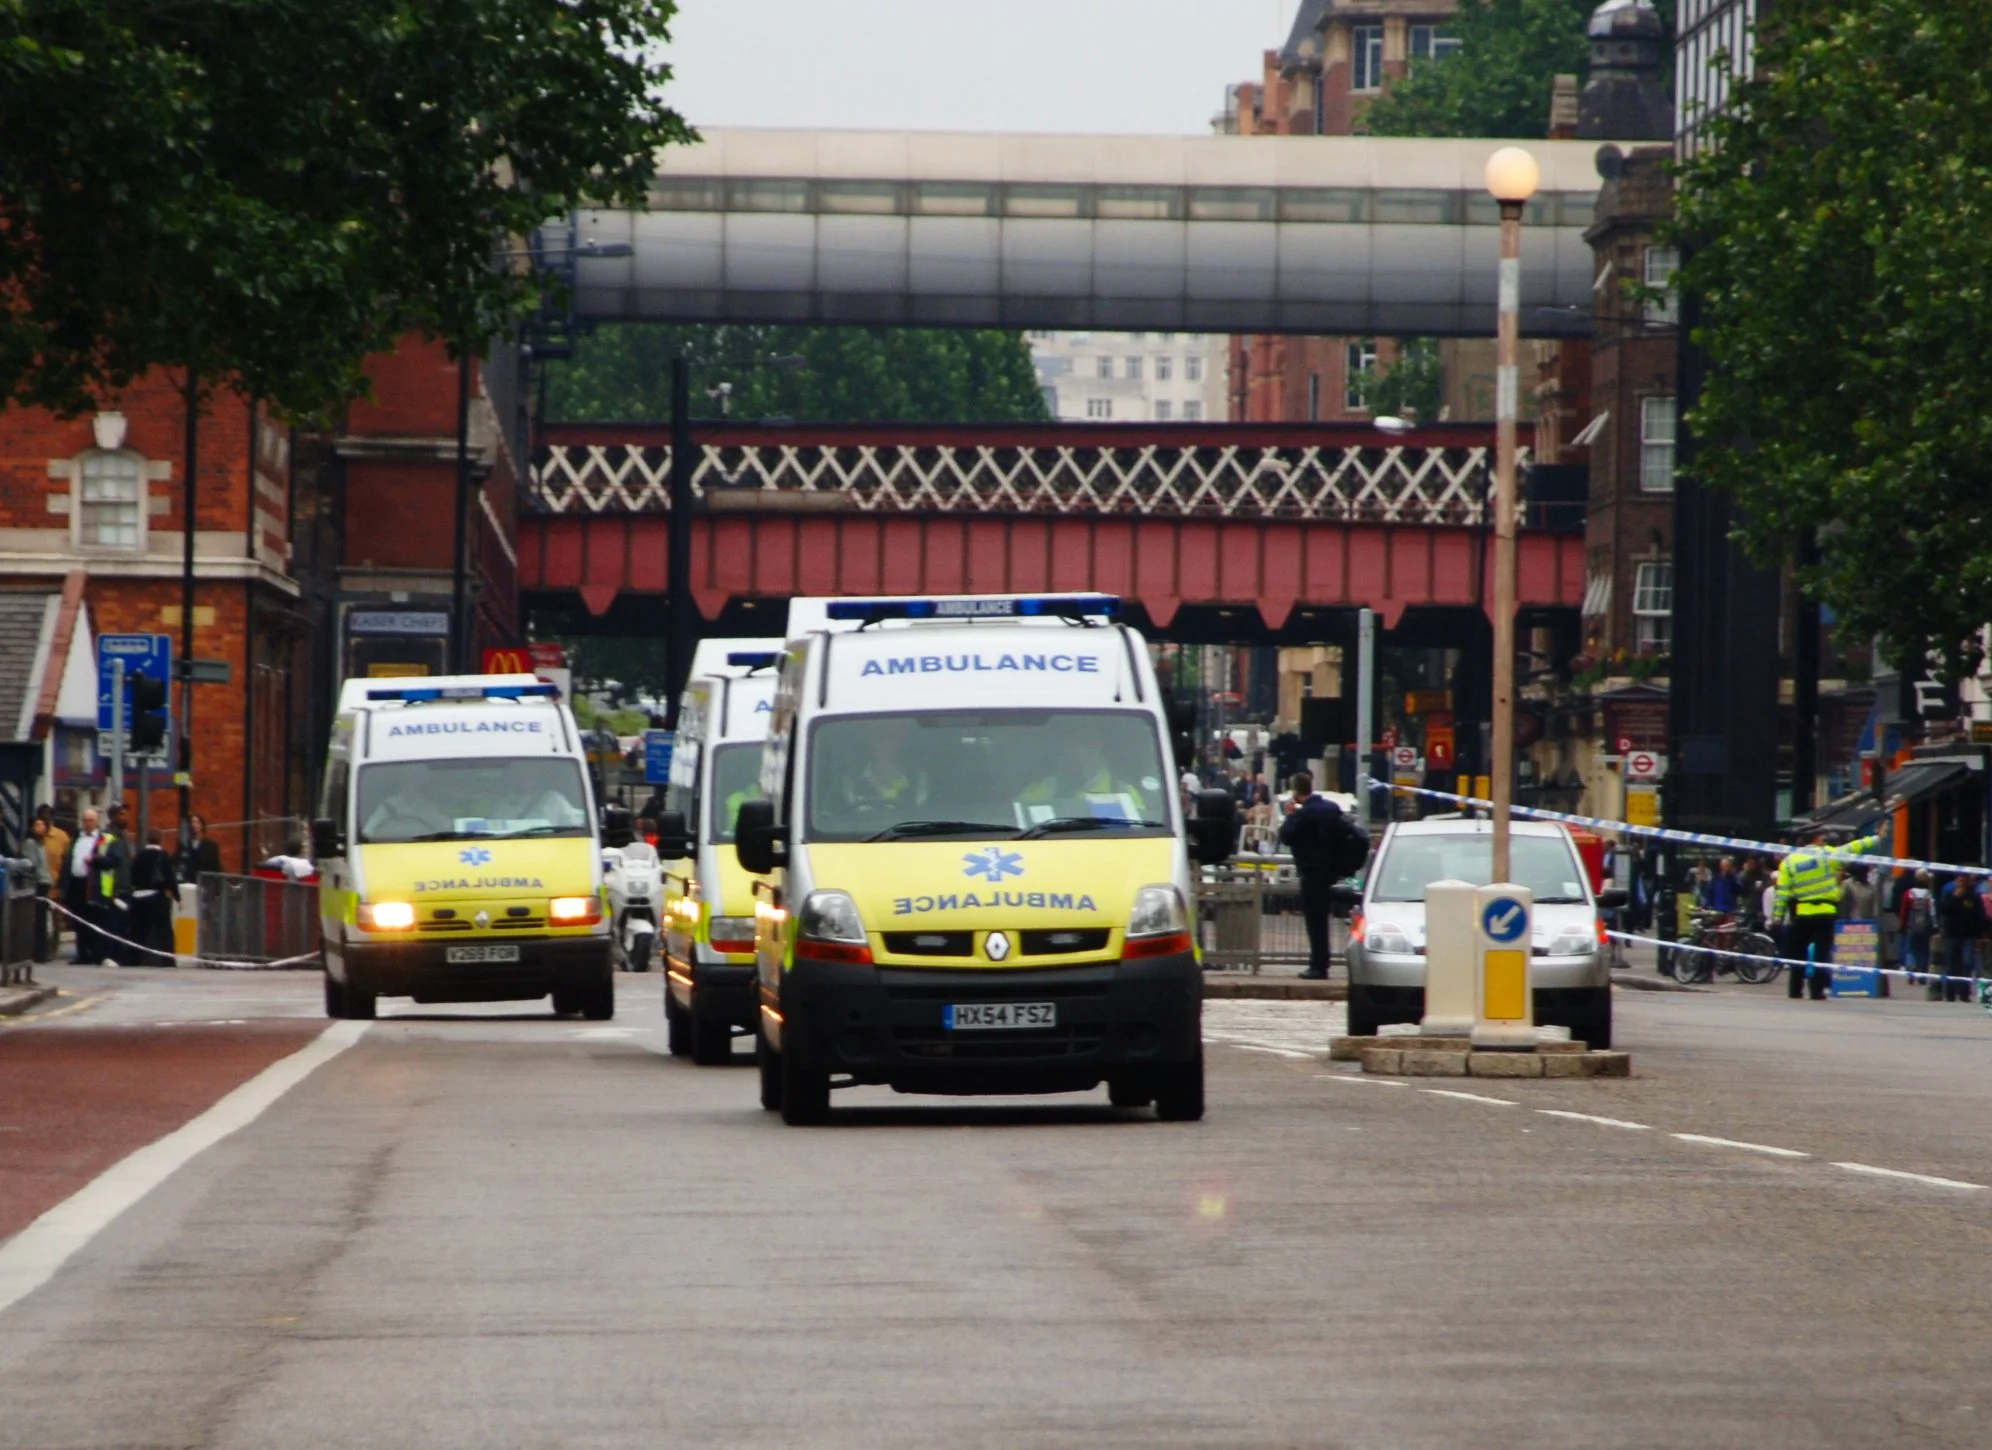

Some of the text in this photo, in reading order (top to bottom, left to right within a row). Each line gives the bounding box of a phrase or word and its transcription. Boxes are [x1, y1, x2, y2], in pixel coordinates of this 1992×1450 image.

[936, 600, 1012, 615] AMBULANCE
[861, 654, 1099, 676] AMBULANCE
[388, 721, 542, 736] AMBULANCE
[955, 1004, 1053, 1026] HX54 FSZ
